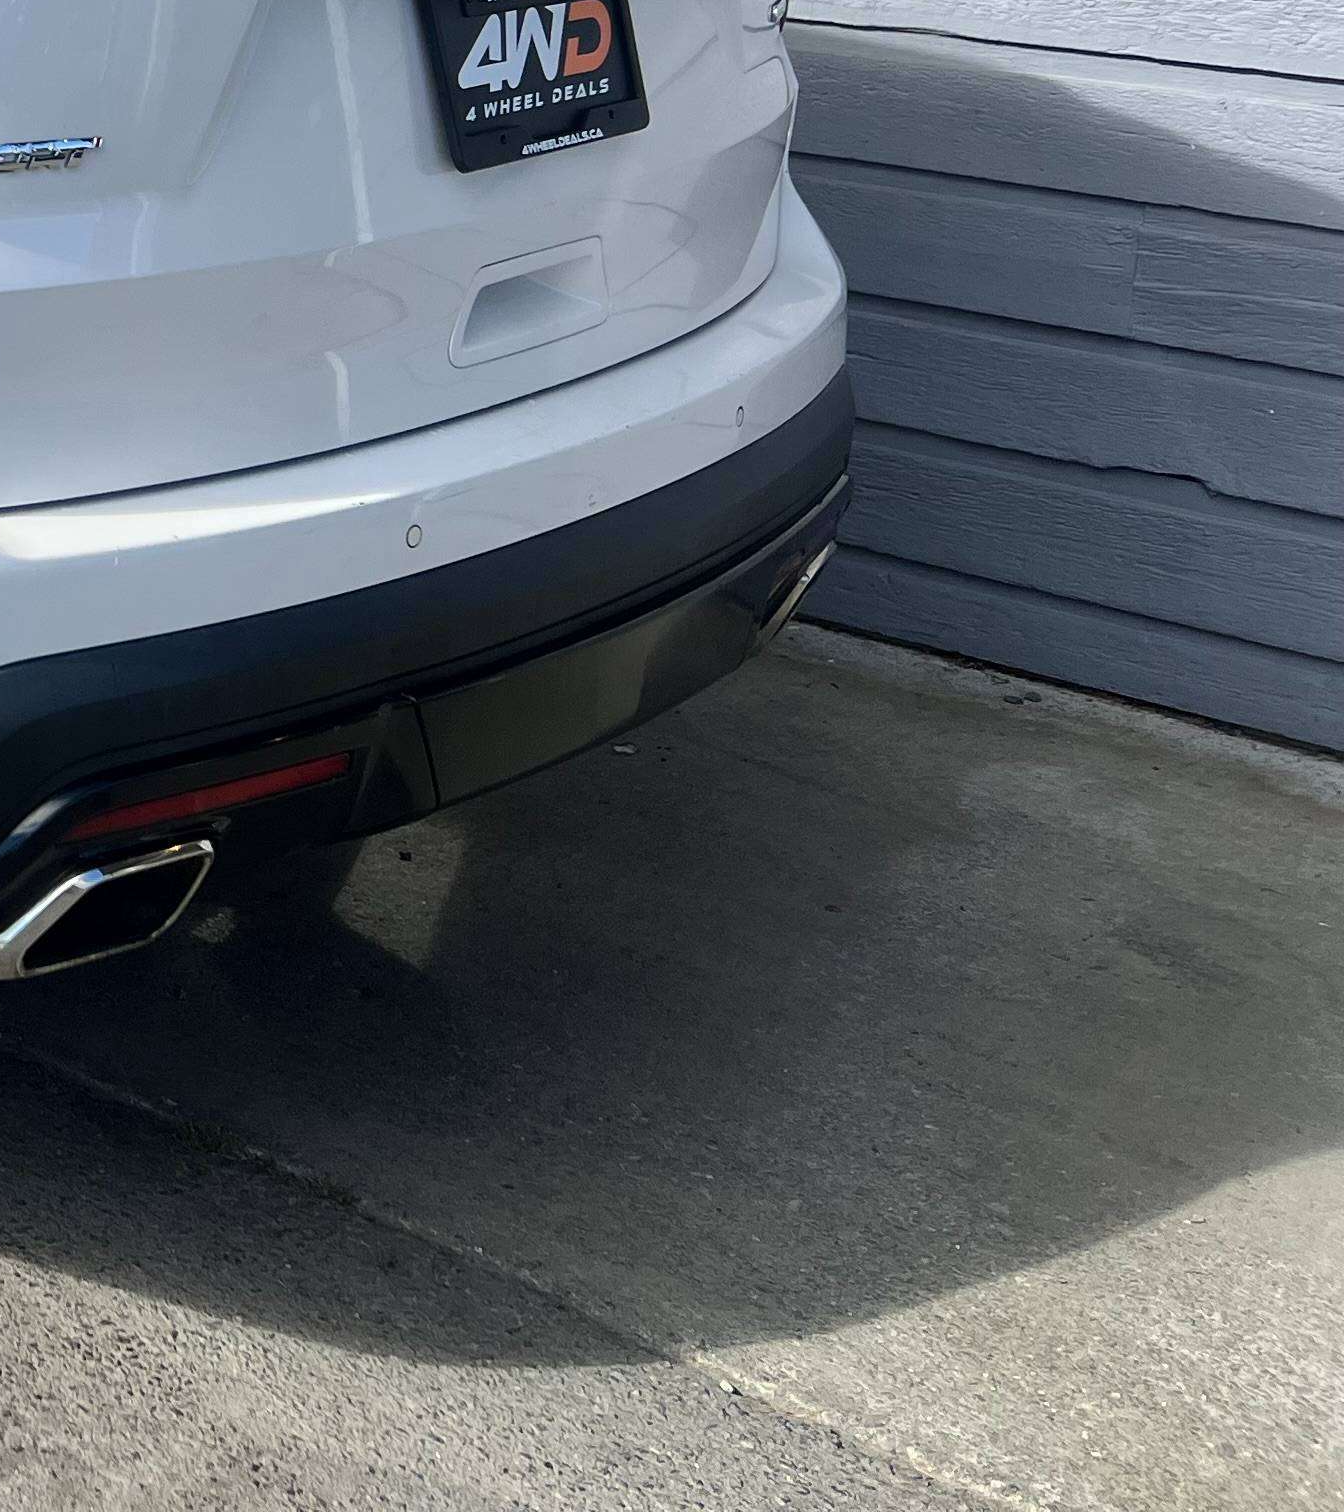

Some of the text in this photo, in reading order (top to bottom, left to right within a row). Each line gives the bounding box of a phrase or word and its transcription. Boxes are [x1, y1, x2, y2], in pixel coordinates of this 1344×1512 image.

[465, 77, 610, 122] 4 WHEEL DEALS
